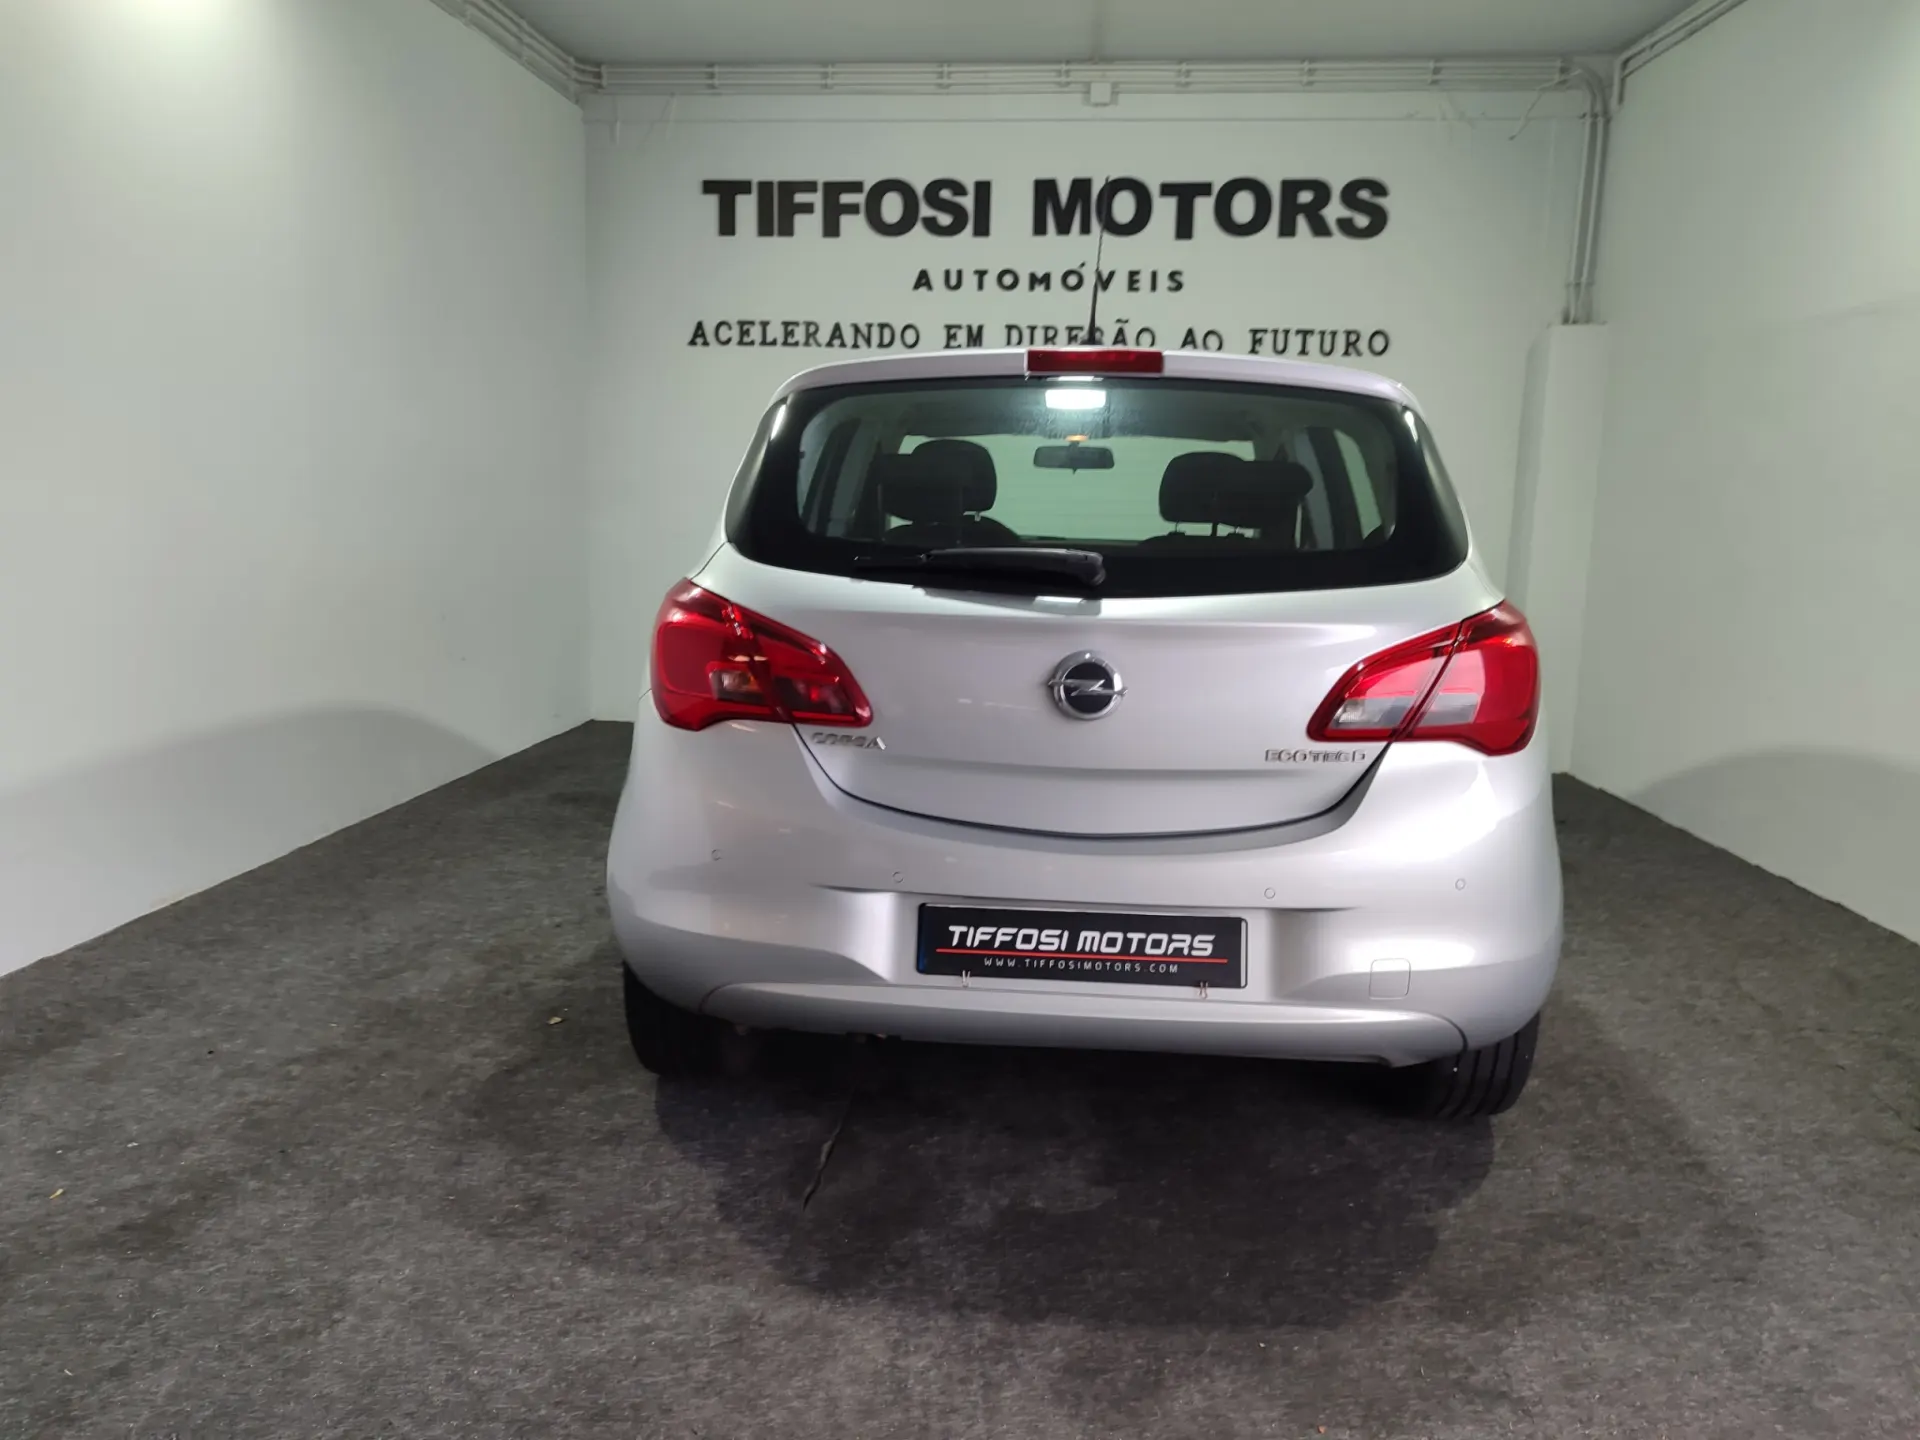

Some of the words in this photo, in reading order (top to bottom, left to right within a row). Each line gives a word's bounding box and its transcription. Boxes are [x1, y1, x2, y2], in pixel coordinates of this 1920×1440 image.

[702, 178, 992, 238] TIFFOSI
[1032, 176, 1390, 240] MOTORS
[912, 262, 1184, 293] AUTOMÓVEIS
[688, 320, 920, 350] ACELERANDO
[944, 324, 984, 349] EM
[1180, 327, 1224, 352] AO
[1248, 328, 1391, 357] FUTURO
[812, 732, 886, 750] CORSA
[948, 925, 1069, 951] TIFFOSI
[1077, 930, 1216, 956] MOTORS
[984, 957, 1179, 973] WWW.TIFFOSIMOTORS.COM
